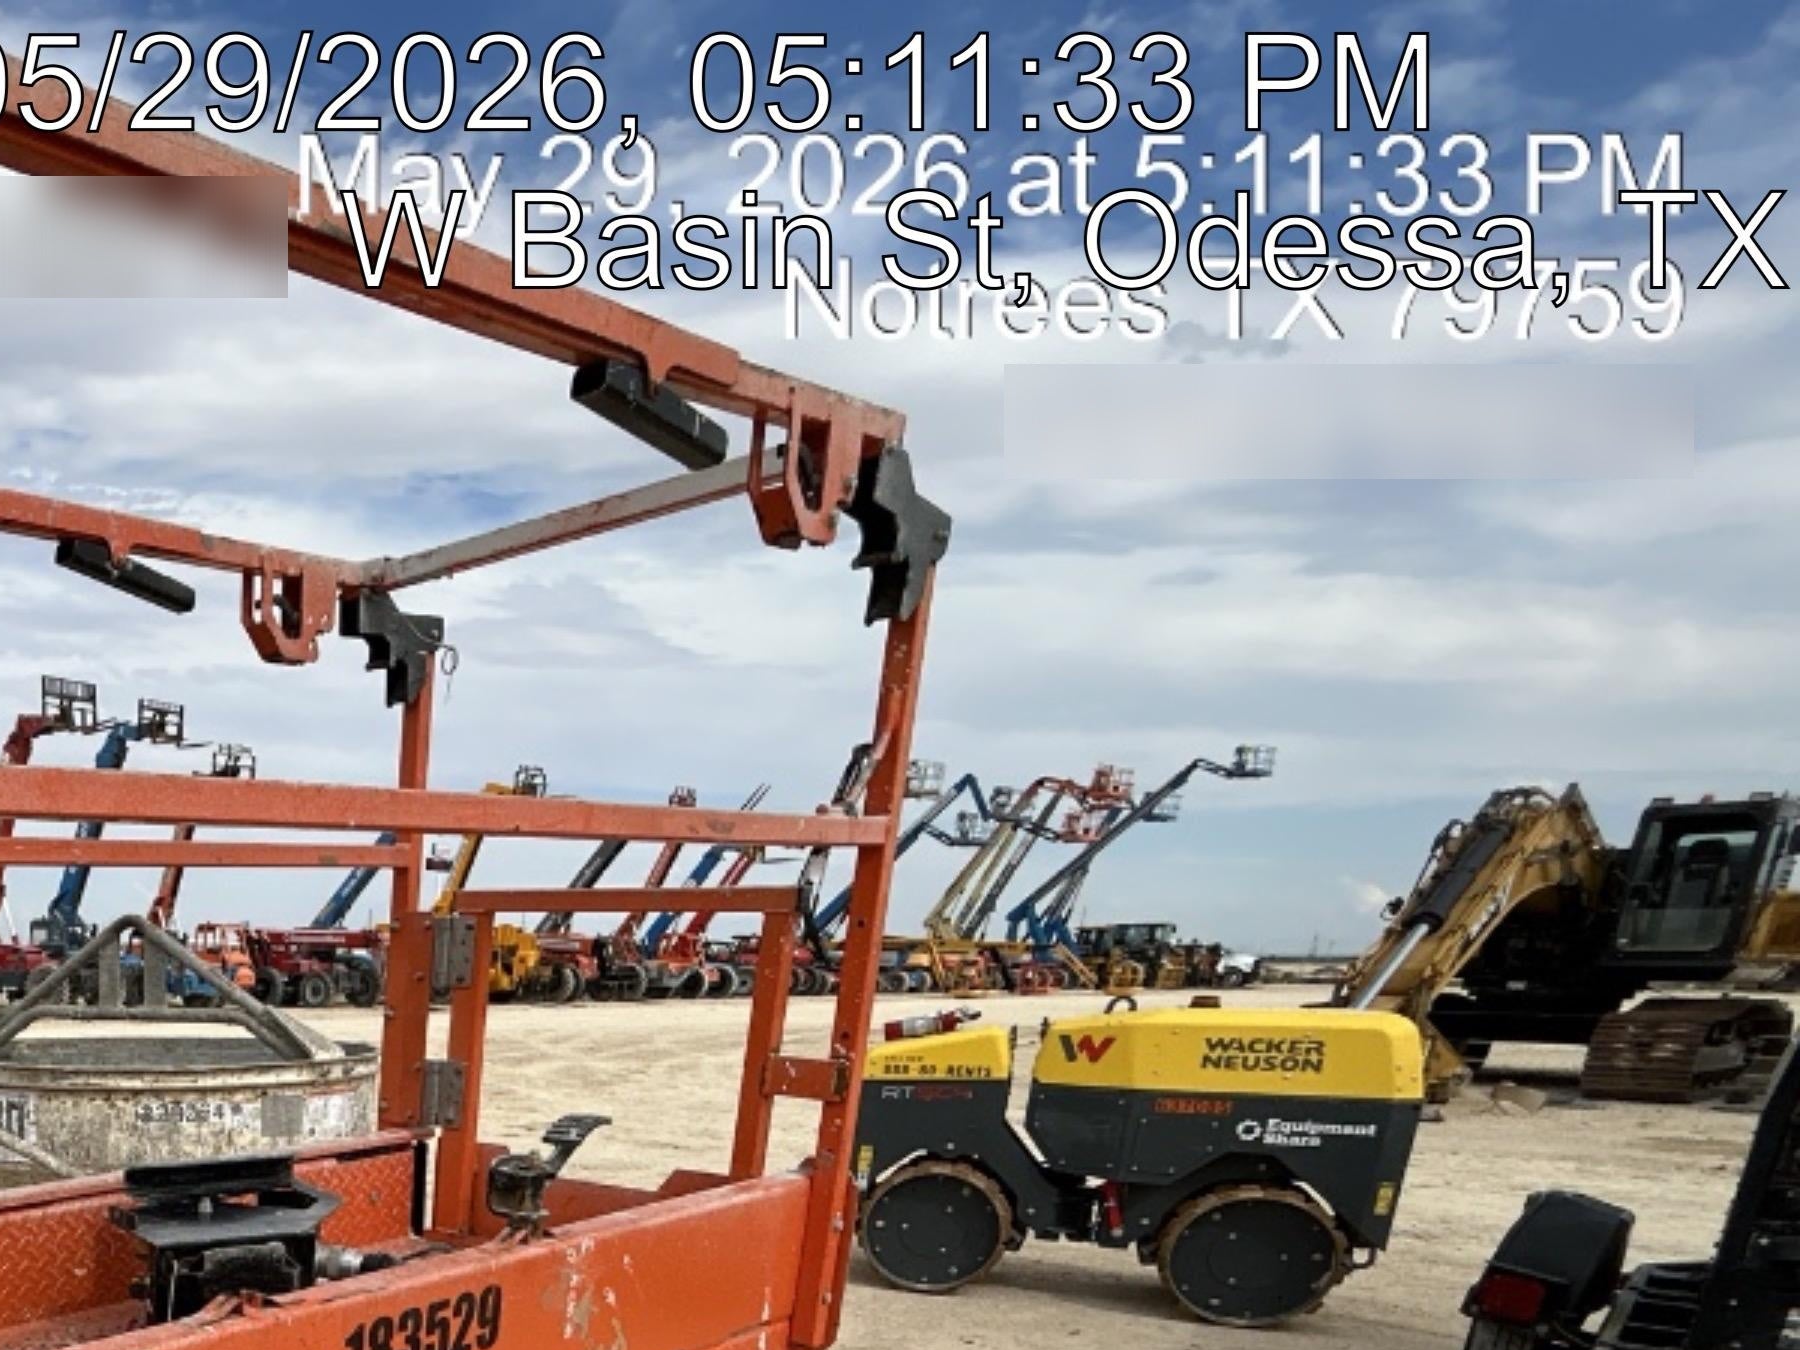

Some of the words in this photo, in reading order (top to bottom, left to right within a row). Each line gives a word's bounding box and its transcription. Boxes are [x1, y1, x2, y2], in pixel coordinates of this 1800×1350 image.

[1204, 1037, 1327, 1056] WACKER
[1201, 1055, 1325, 1073] NEUSON
[1266, 1117, 1379, 1138] Equipment
[1262, 1132, 1322, 1147] Share
